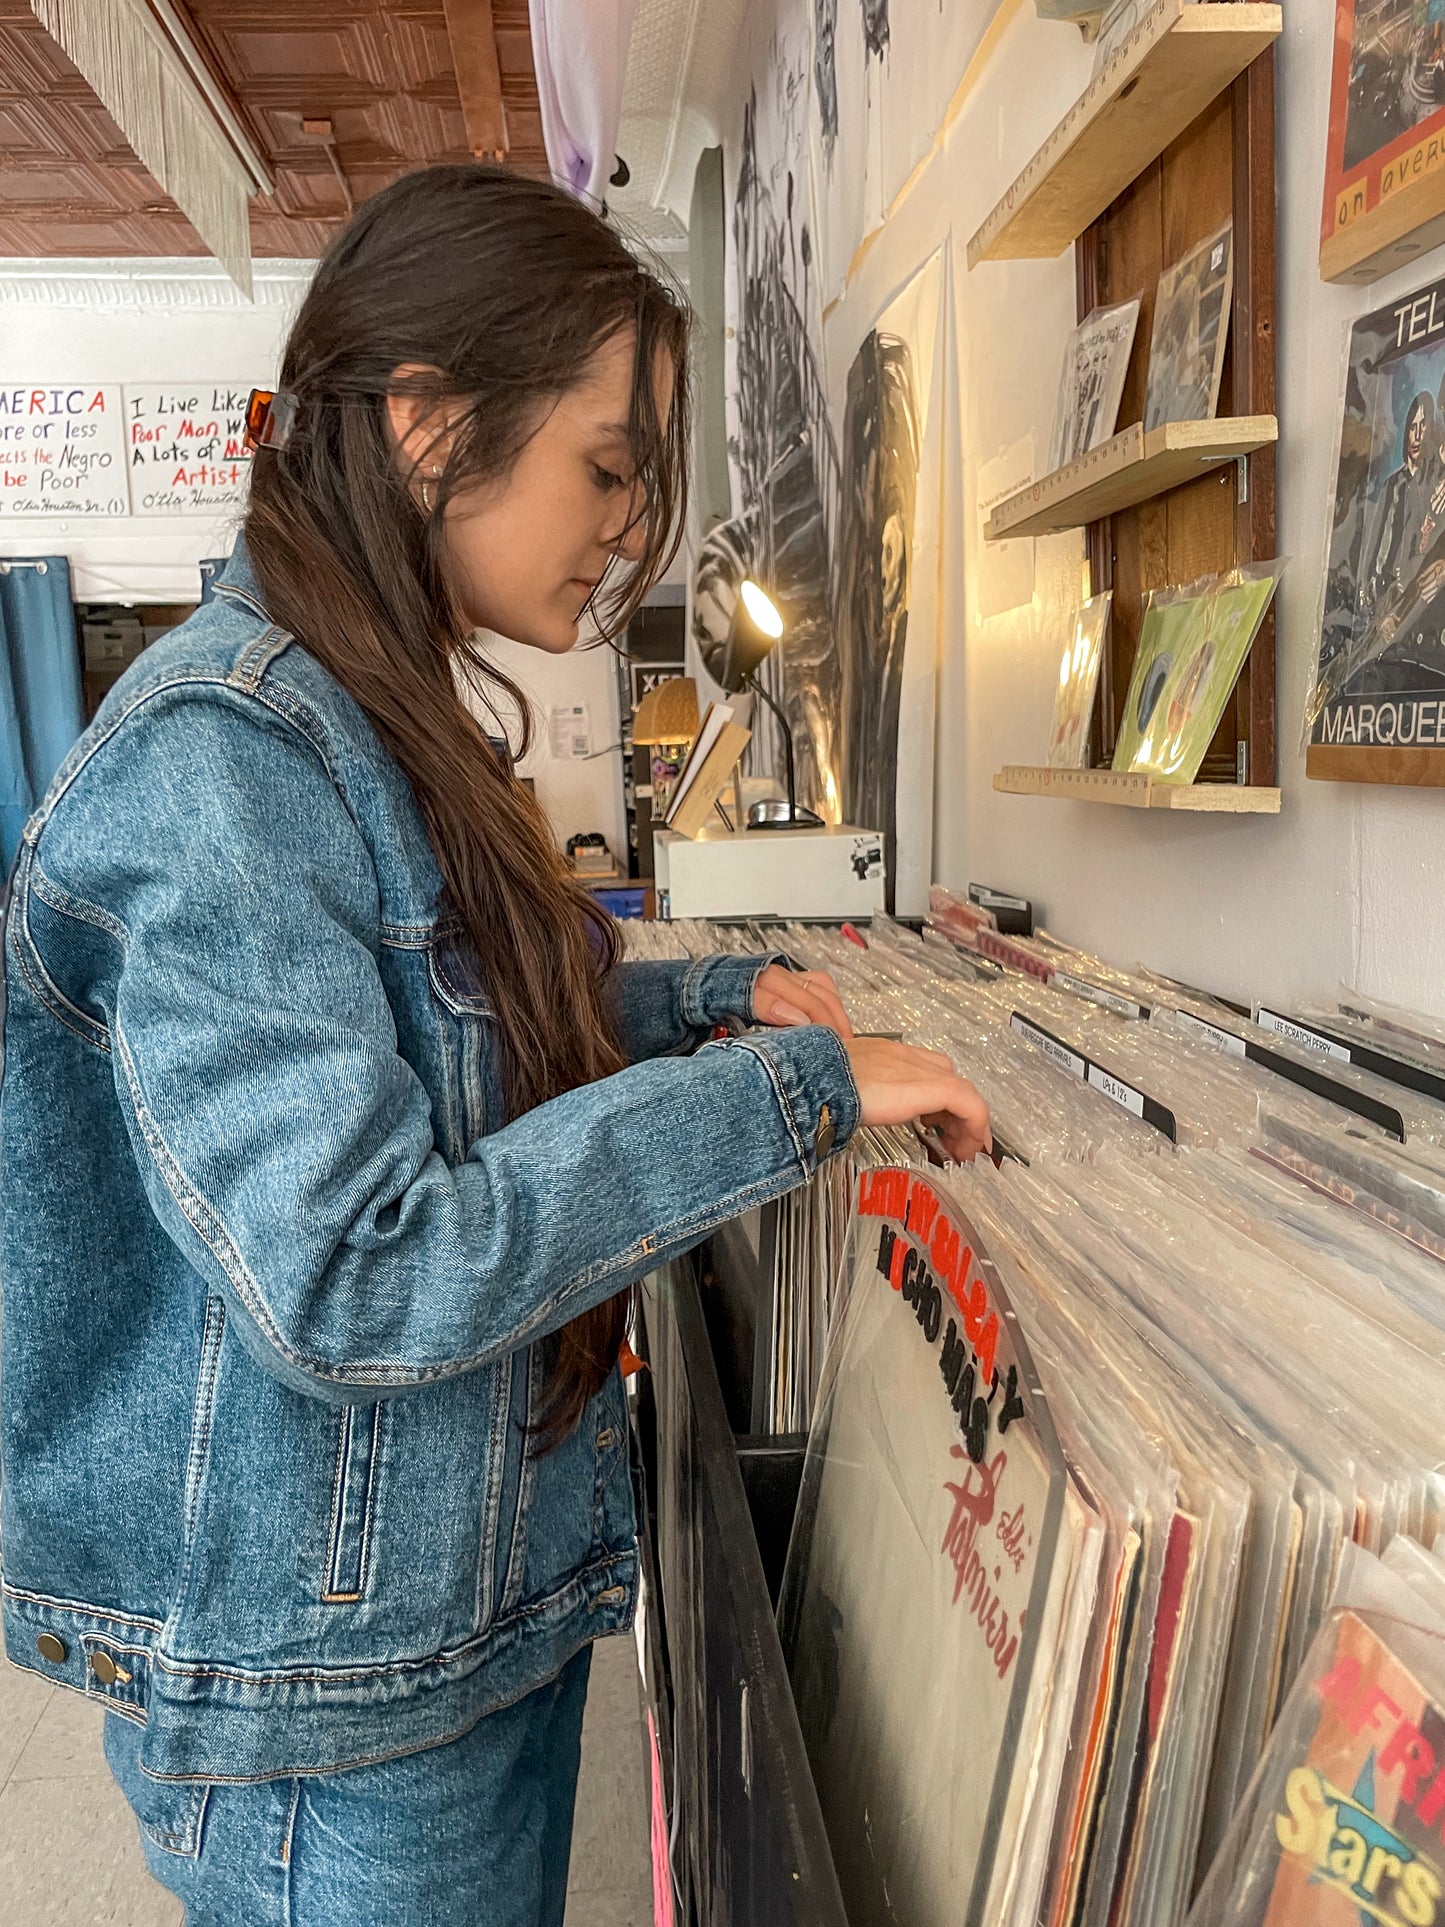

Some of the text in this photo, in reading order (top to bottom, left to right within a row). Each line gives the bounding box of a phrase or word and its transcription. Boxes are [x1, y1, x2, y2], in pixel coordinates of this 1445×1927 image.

[130, 389, 247, 419] I Live Like
[32, 422, 55, 439] or
[65, 420, 98, 439] less
[131, 422, 168, 445] Poor
[58, 444, 112, 474] Negro
[132, 448, 145, 466] A
[152, 442, 190, 461] Lots
[197, 438, 221, 461] of
[4, 469, 88, 492] be Poor
[171, 464, 240, 487] Artist
[1274, 1019, 1331, 1055] LEE SCRATCH PERRY
[1275, 1766, 1443, 1927] Stars
